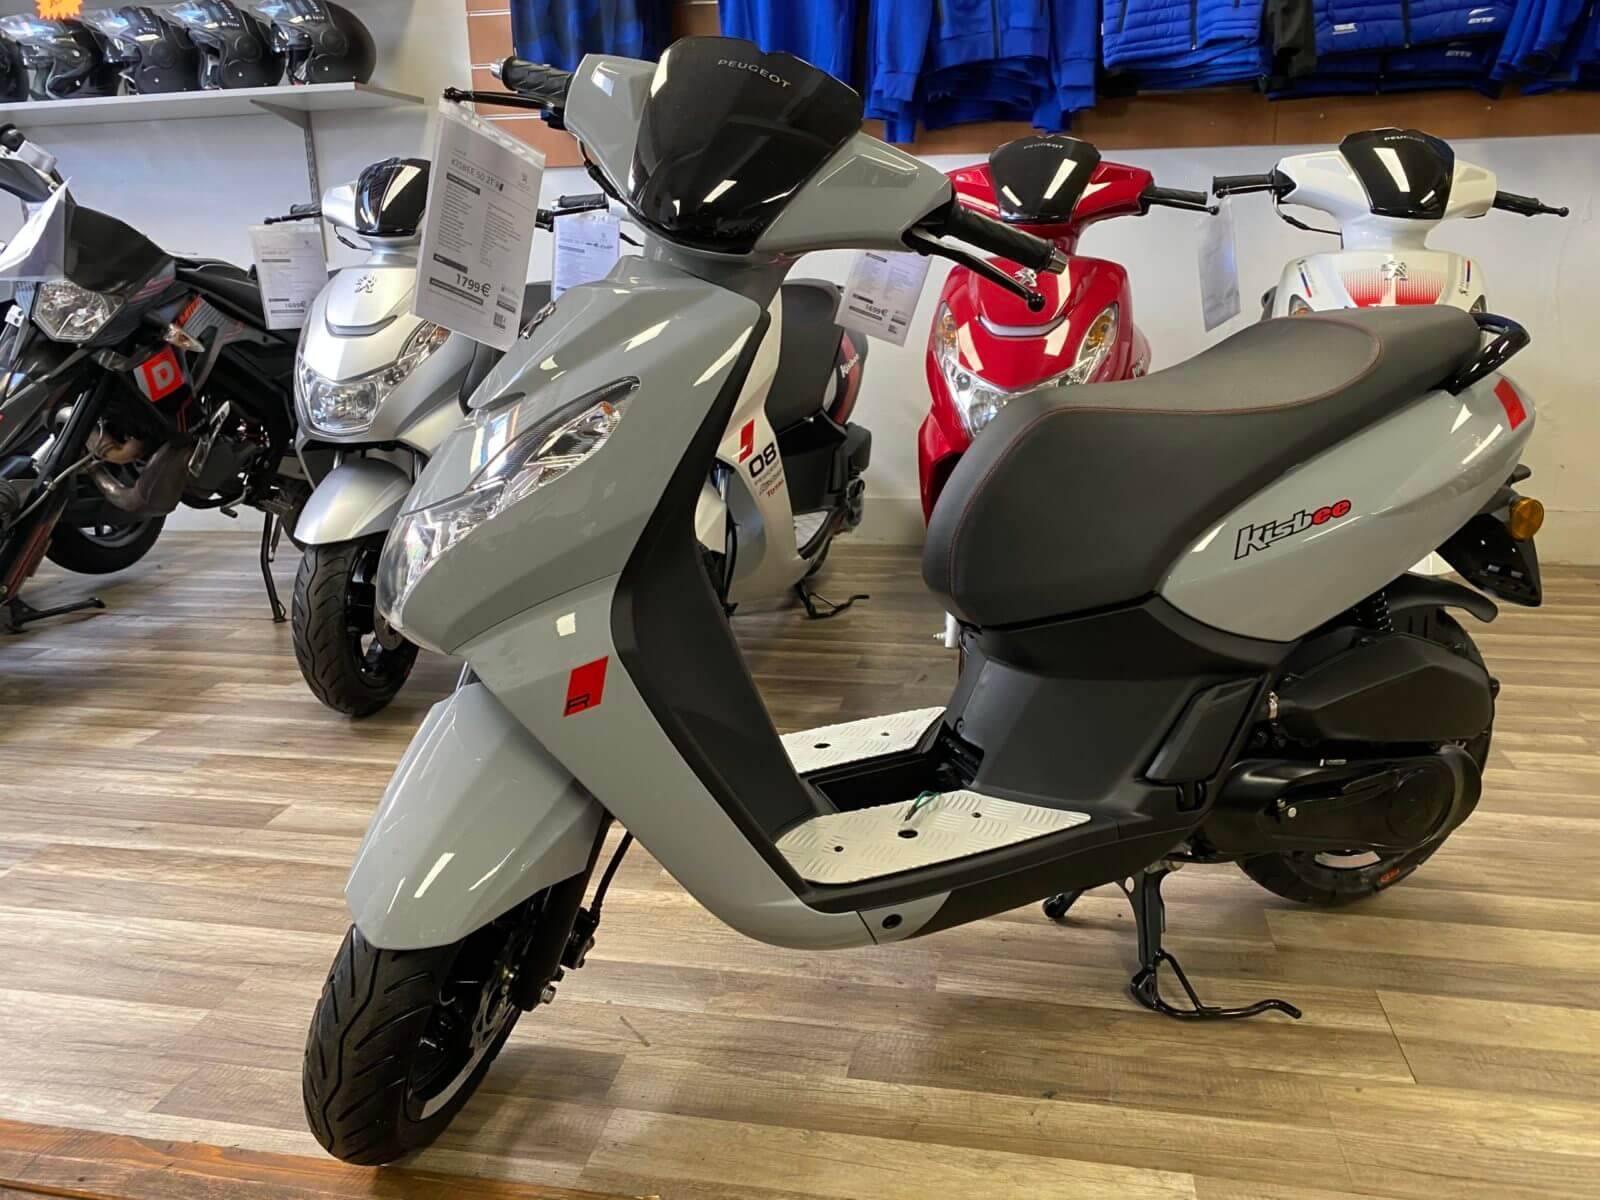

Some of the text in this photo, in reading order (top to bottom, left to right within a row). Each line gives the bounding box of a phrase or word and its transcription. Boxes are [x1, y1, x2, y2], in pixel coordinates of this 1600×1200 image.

[718, 59, 792, 88] PEUGEOT
[456, 273, 492, 298] 1799€
[749, 442, 777, 478] 08
[1234, 499, 1351, 560] Kisbee
